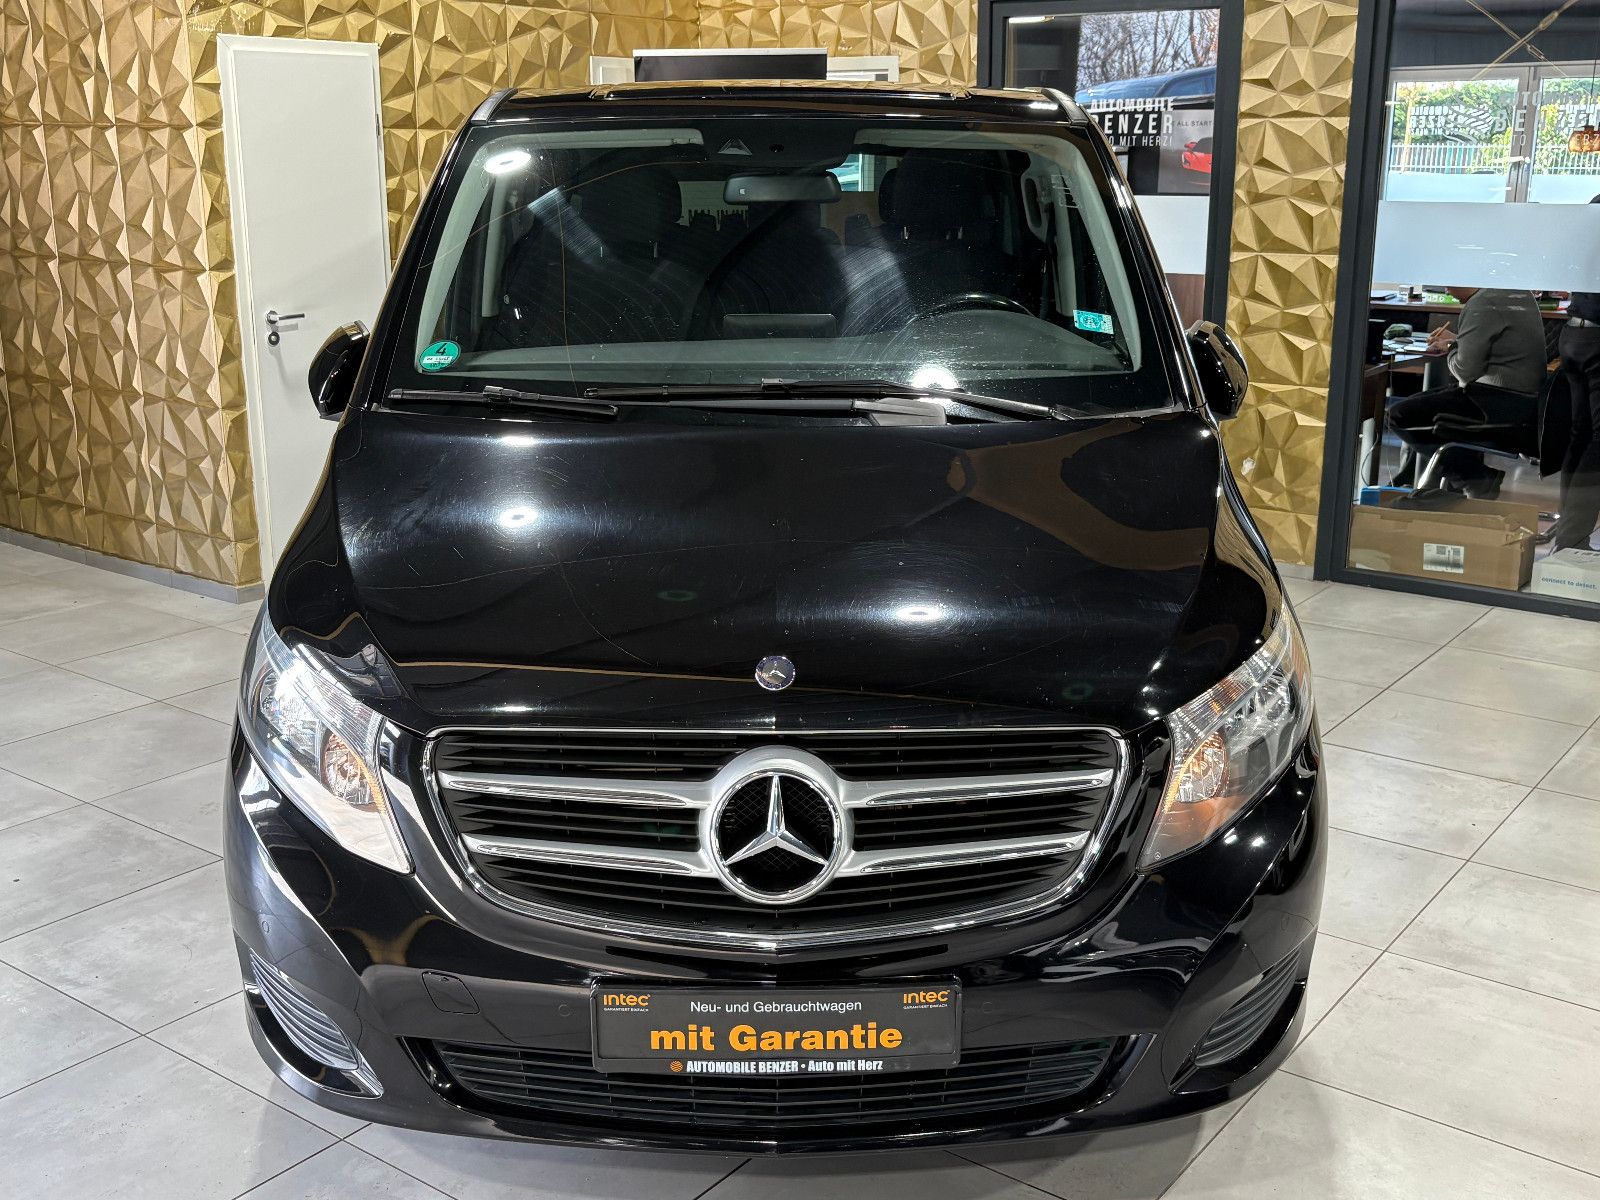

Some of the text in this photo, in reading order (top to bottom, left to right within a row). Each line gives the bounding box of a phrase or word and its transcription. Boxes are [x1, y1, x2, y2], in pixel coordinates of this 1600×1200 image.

[1091, 97, 1174, 112] AUTOMOBILE
[1119, 136, 1137, 147] MIT
[436, 343, 448, 355] 4
[603, 993, 649, 1006] intec
[903, 990, 949, 1004] intec
[690, 1000, 862, 1014] Neu- und Gebrauchtwagen
[650, 1021, 903, 1052] mit Garantie
[686, 1059, 884, 1073] AUTOMOBILE BENZER Auto mit Herz
